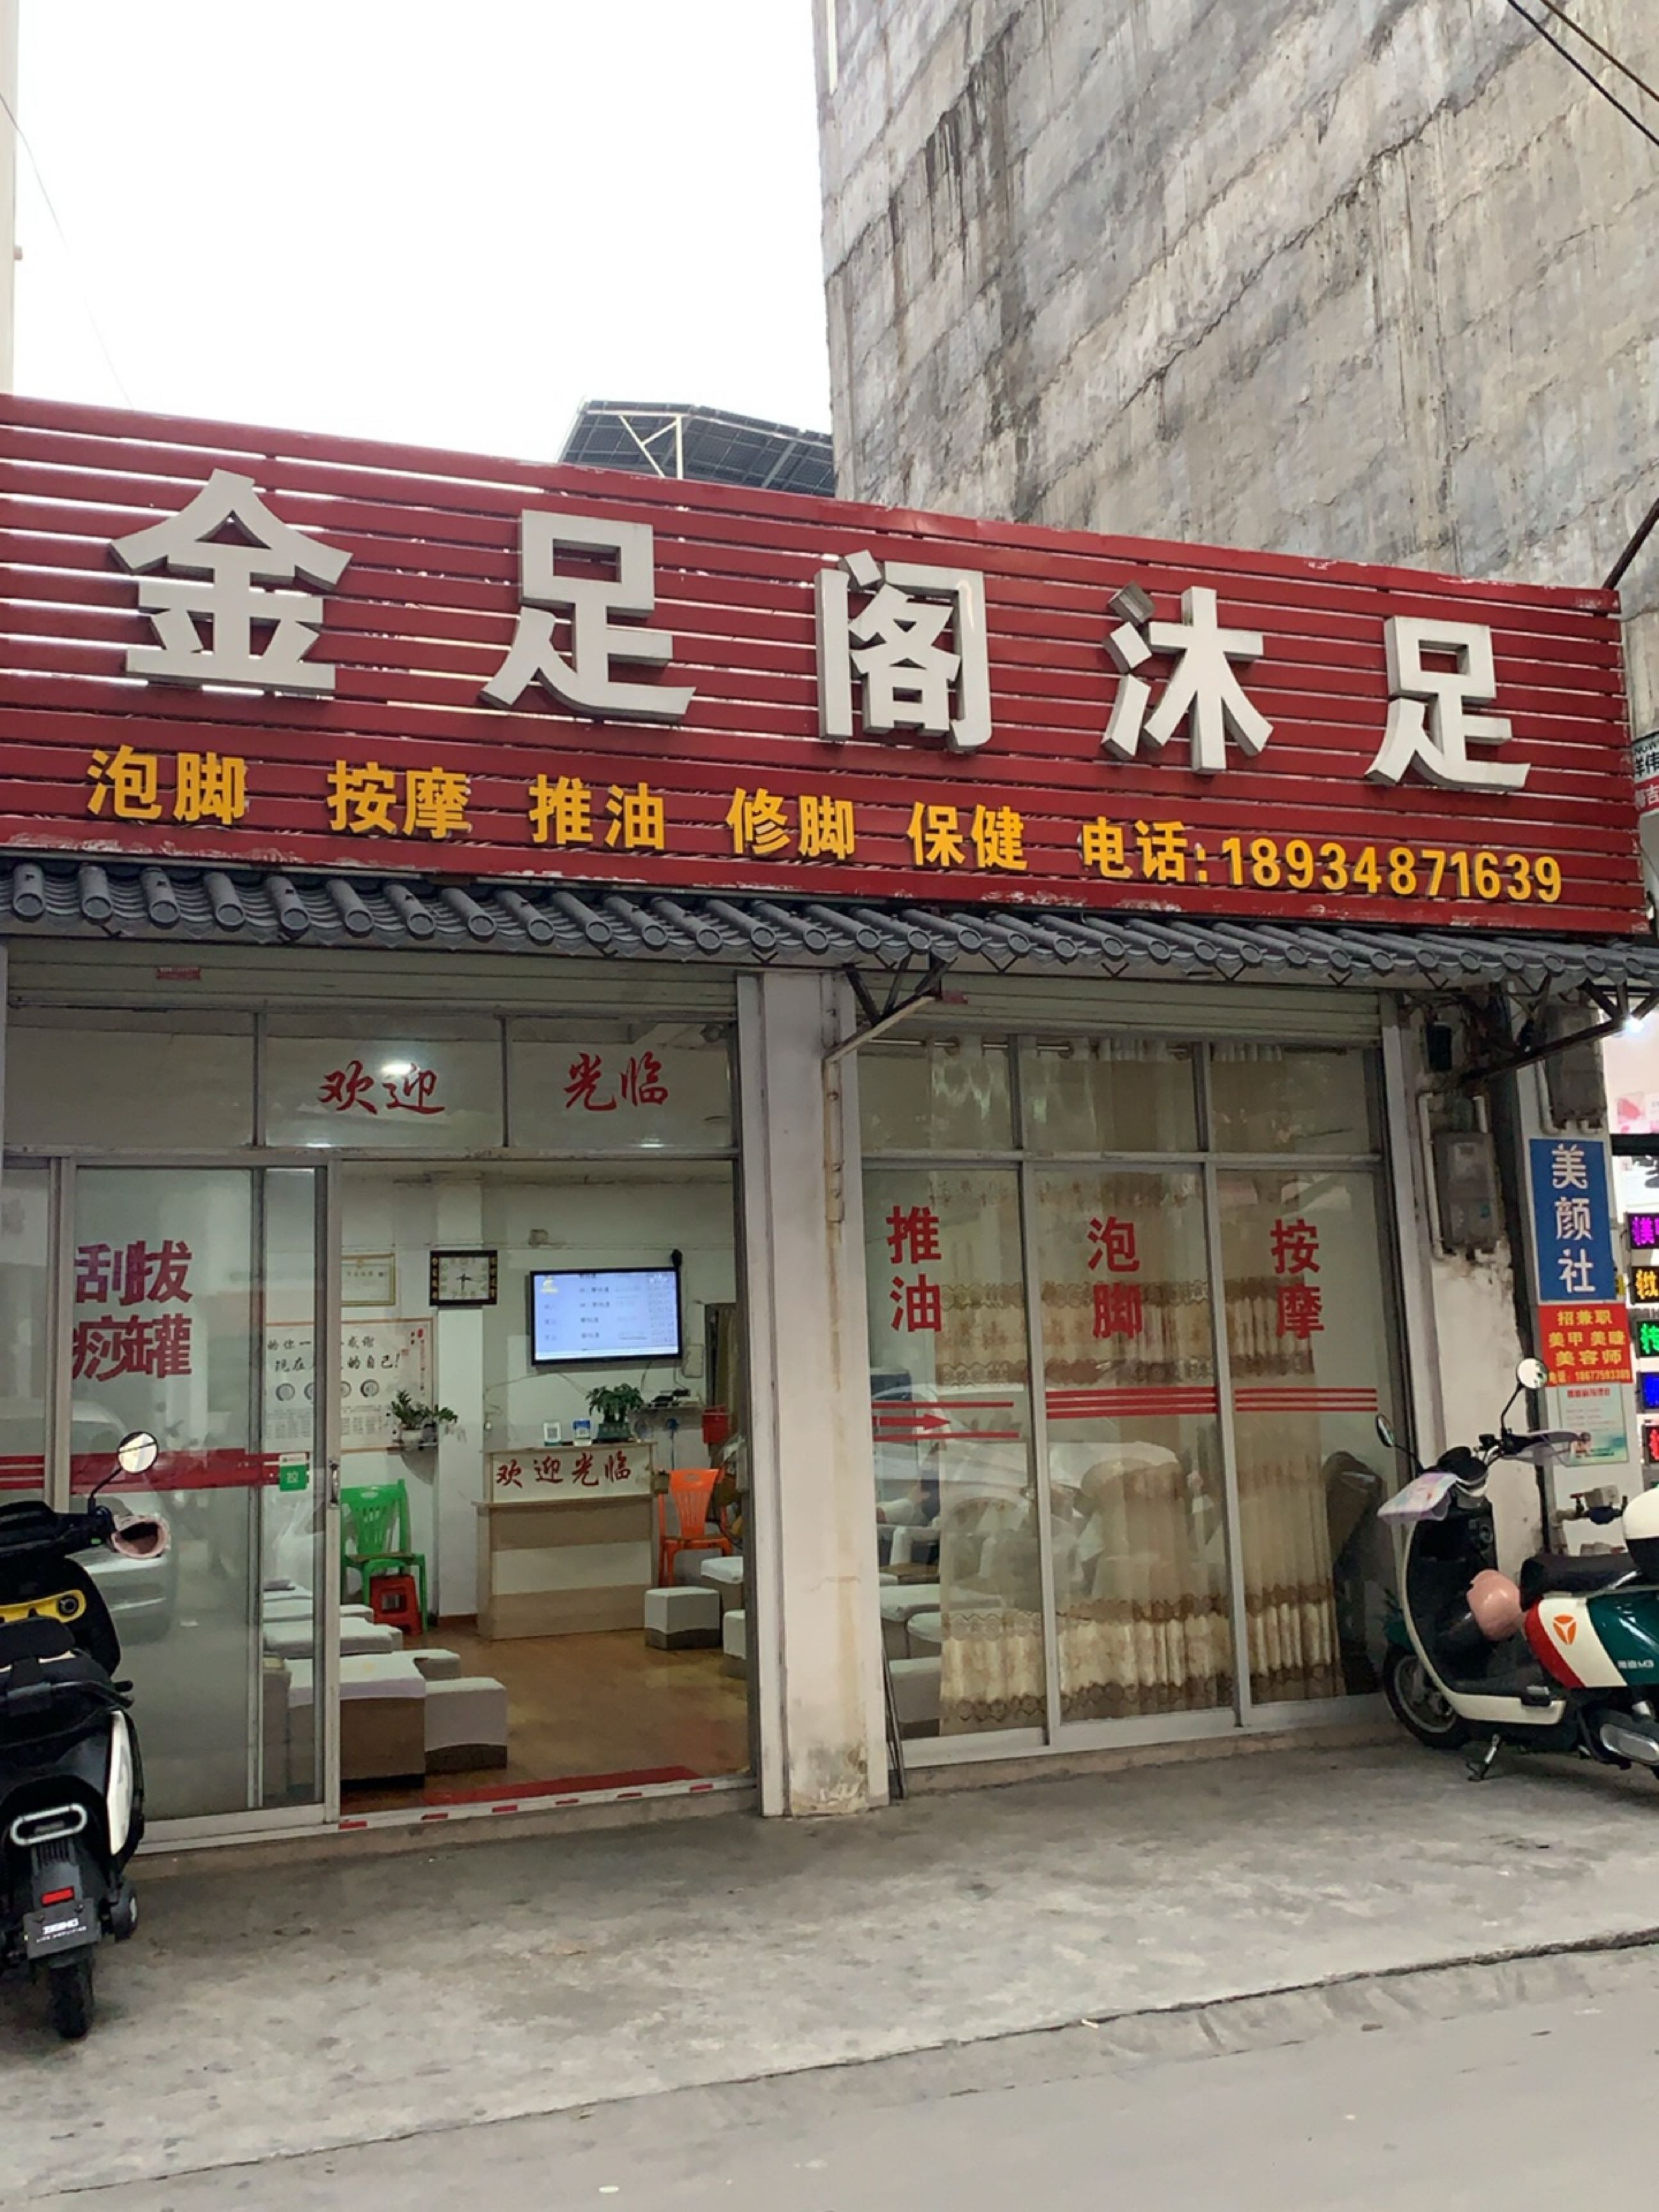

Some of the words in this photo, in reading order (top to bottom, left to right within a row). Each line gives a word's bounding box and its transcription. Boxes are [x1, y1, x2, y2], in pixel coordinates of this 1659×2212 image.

[109, 467, 1531, 792] 金足阁沐足
[86, 745, 248, 826] 泡脚
[326, 760, 471, 838] 按摩
[528, 774, 665, 851] 推油
[725, 787, 856, 860] 修脚
[906, 801, 1027, 871] 保健
[318, 1060, 445, 1115] 欢迎
[563, 1051, 669, 1111] 光临
[886, 1206, 942, 1333] 推油
[1087, 1216, 1144, 1340] 泡脚
[1270, 1219, 1325, 1339] 按摩
[1551, 1142, 1596, 1293] 美颜社
[496, 1450, 631, 1488] 欢迎光临
